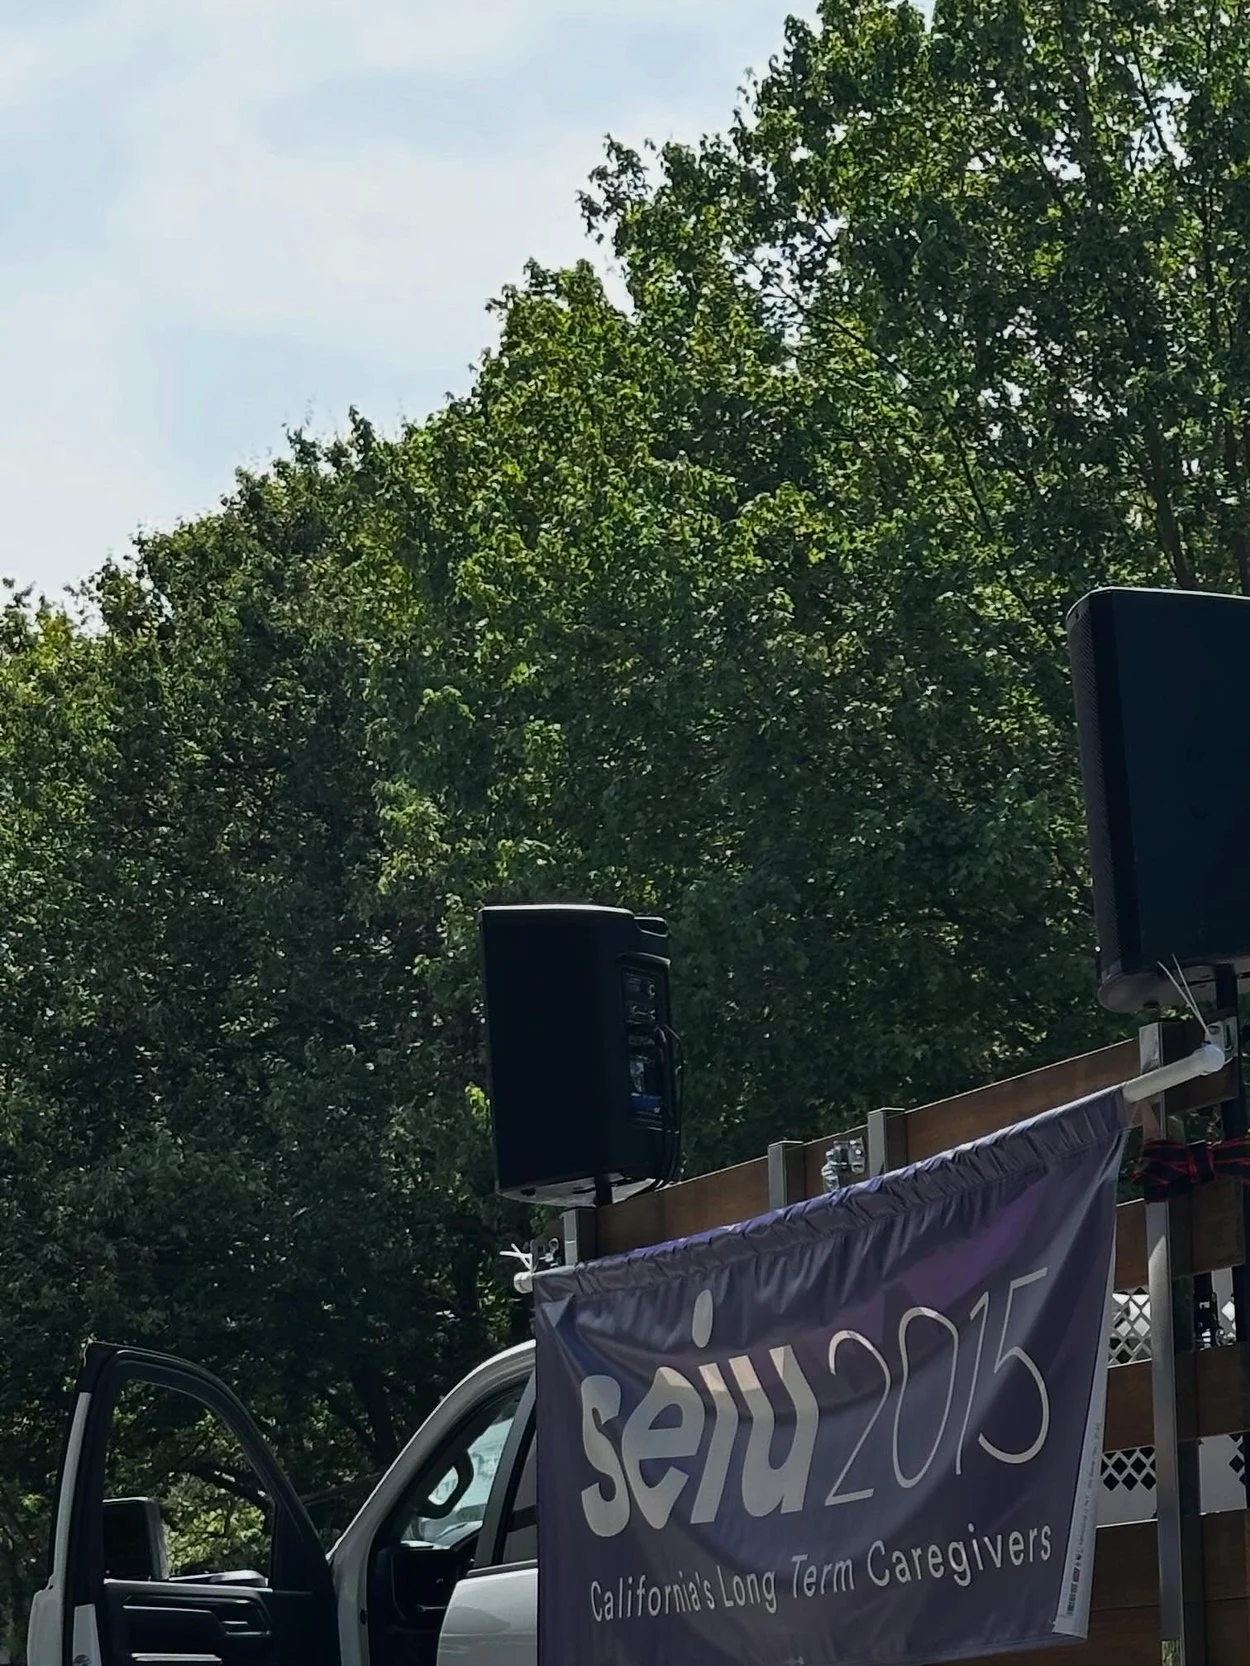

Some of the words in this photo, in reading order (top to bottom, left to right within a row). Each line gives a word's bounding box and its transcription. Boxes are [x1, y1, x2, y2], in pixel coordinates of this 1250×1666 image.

[581, 1289, 819, 1537] seiu
[825, 1267, 1050, 1506] 2015
[590, 1568, 715, 1622] California's
[720, 1564, 777, 1614] Long
[791, 1553, 856, 1599] Term
[867, 1522, 1052, 1587] Caregivers
